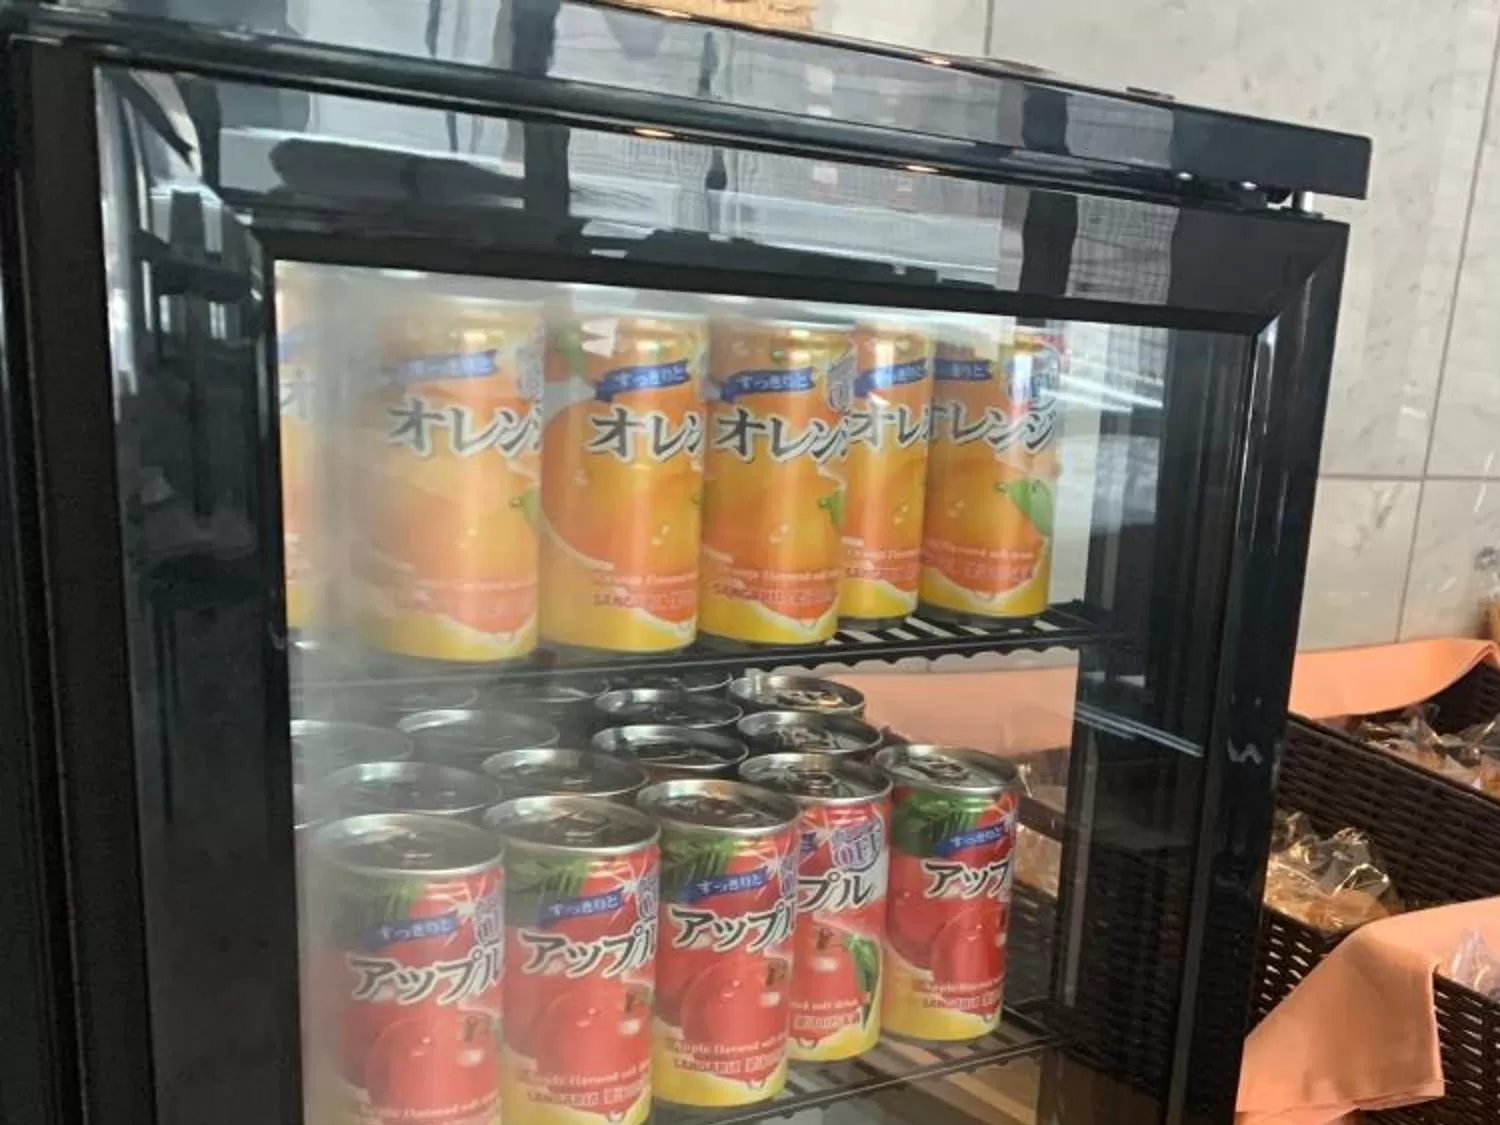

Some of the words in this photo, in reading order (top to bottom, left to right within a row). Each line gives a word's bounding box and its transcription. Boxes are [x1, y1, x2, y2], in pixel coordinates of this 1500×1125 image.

[586, 403, 704, 461] オレン
[797, 867, 876, 910] プル
